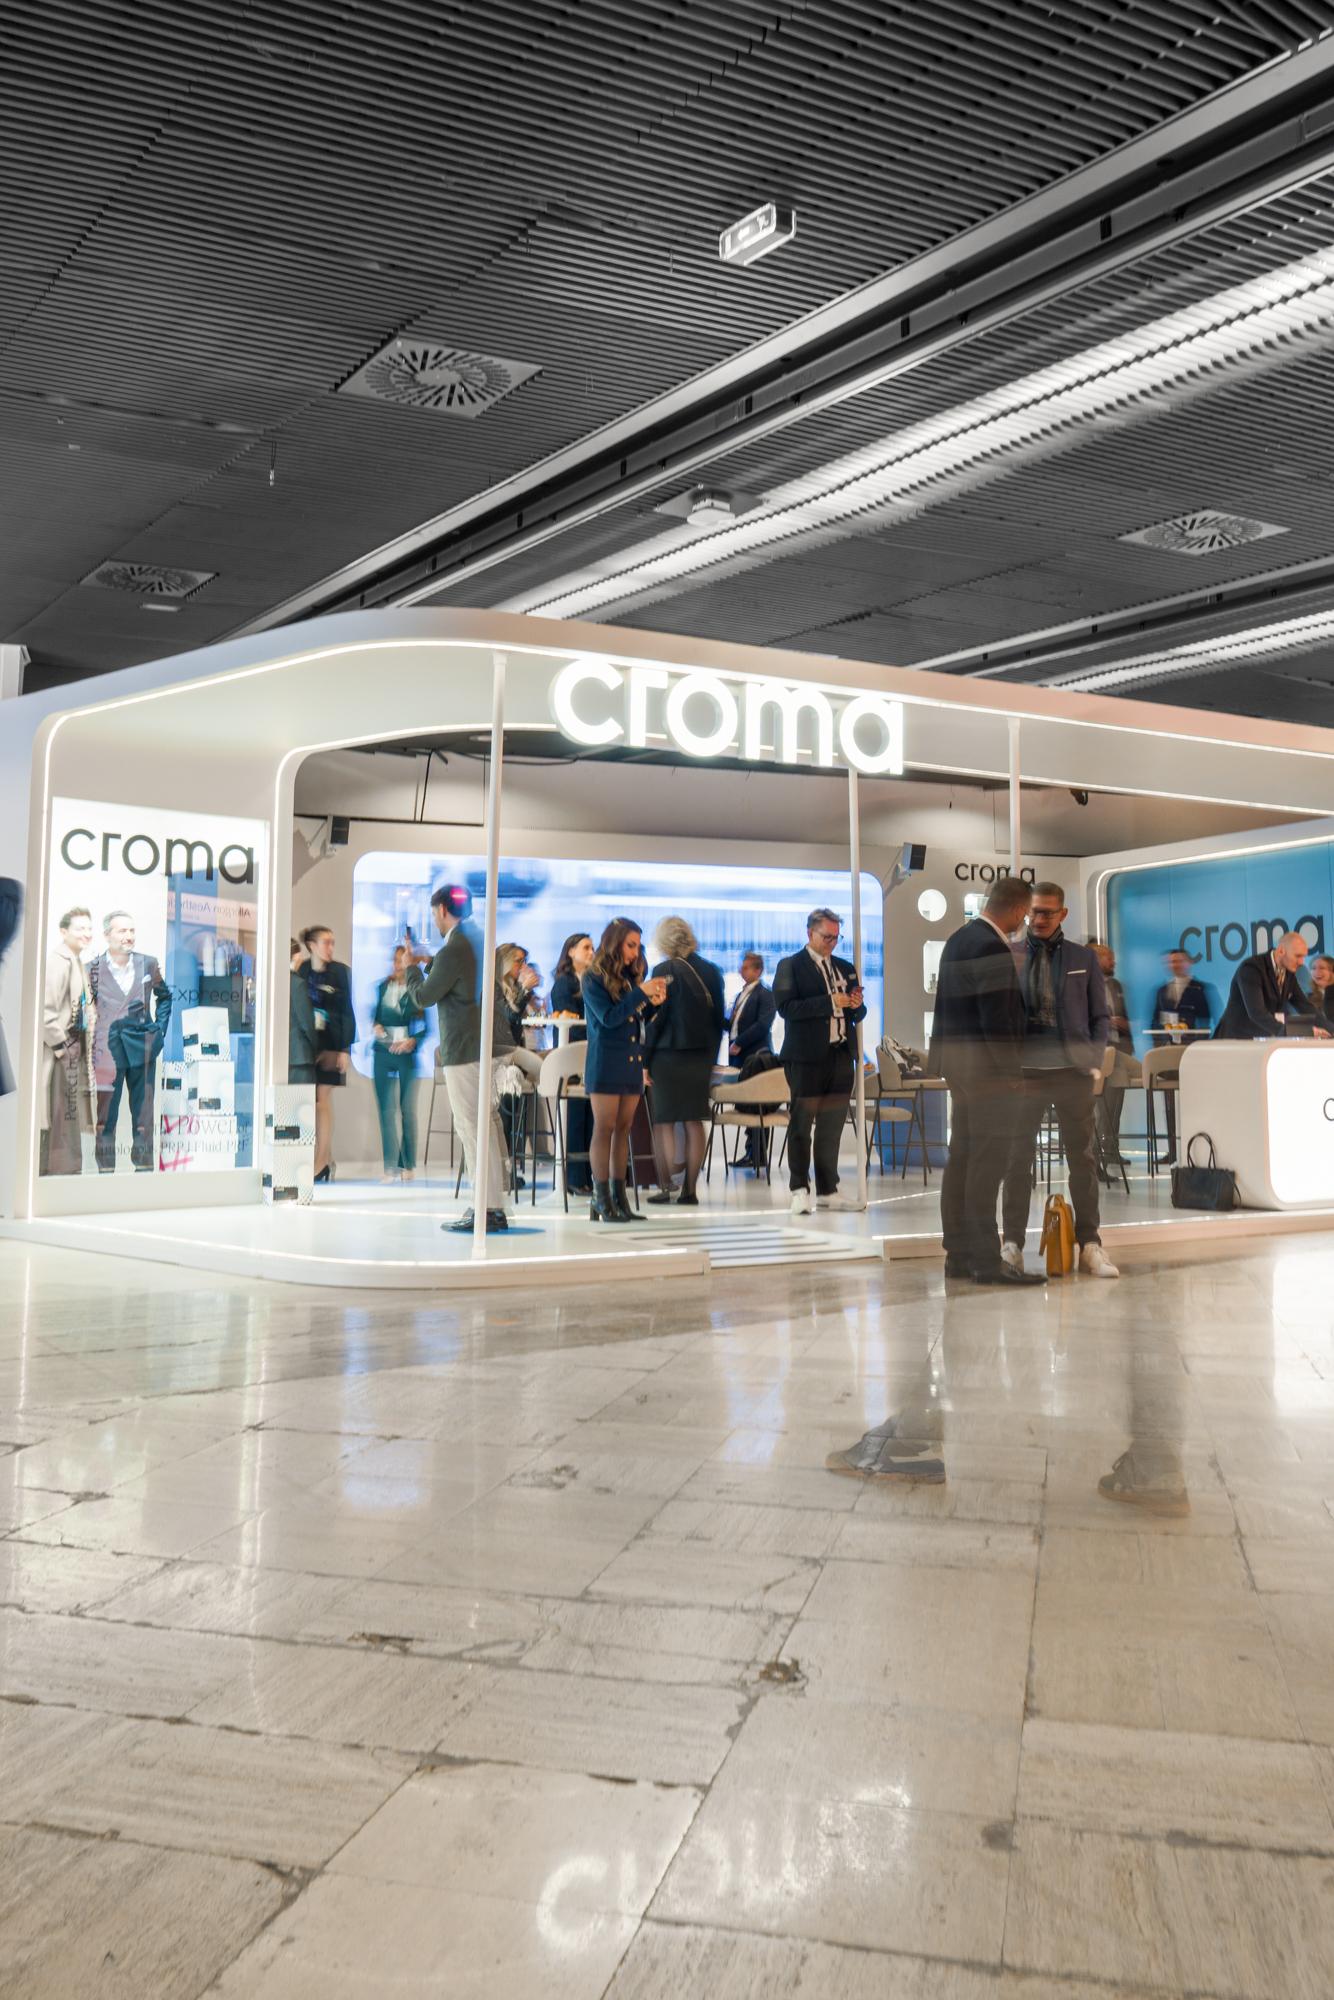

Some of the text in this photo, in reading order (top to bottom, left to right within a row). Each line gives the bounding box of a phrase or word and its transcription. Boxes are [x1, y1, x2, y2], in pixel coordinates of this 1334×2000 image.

[551, 657, 904, 775] croma
[61, 828, 254, 885] croma
[1179, 915, 1325, 964] croma
